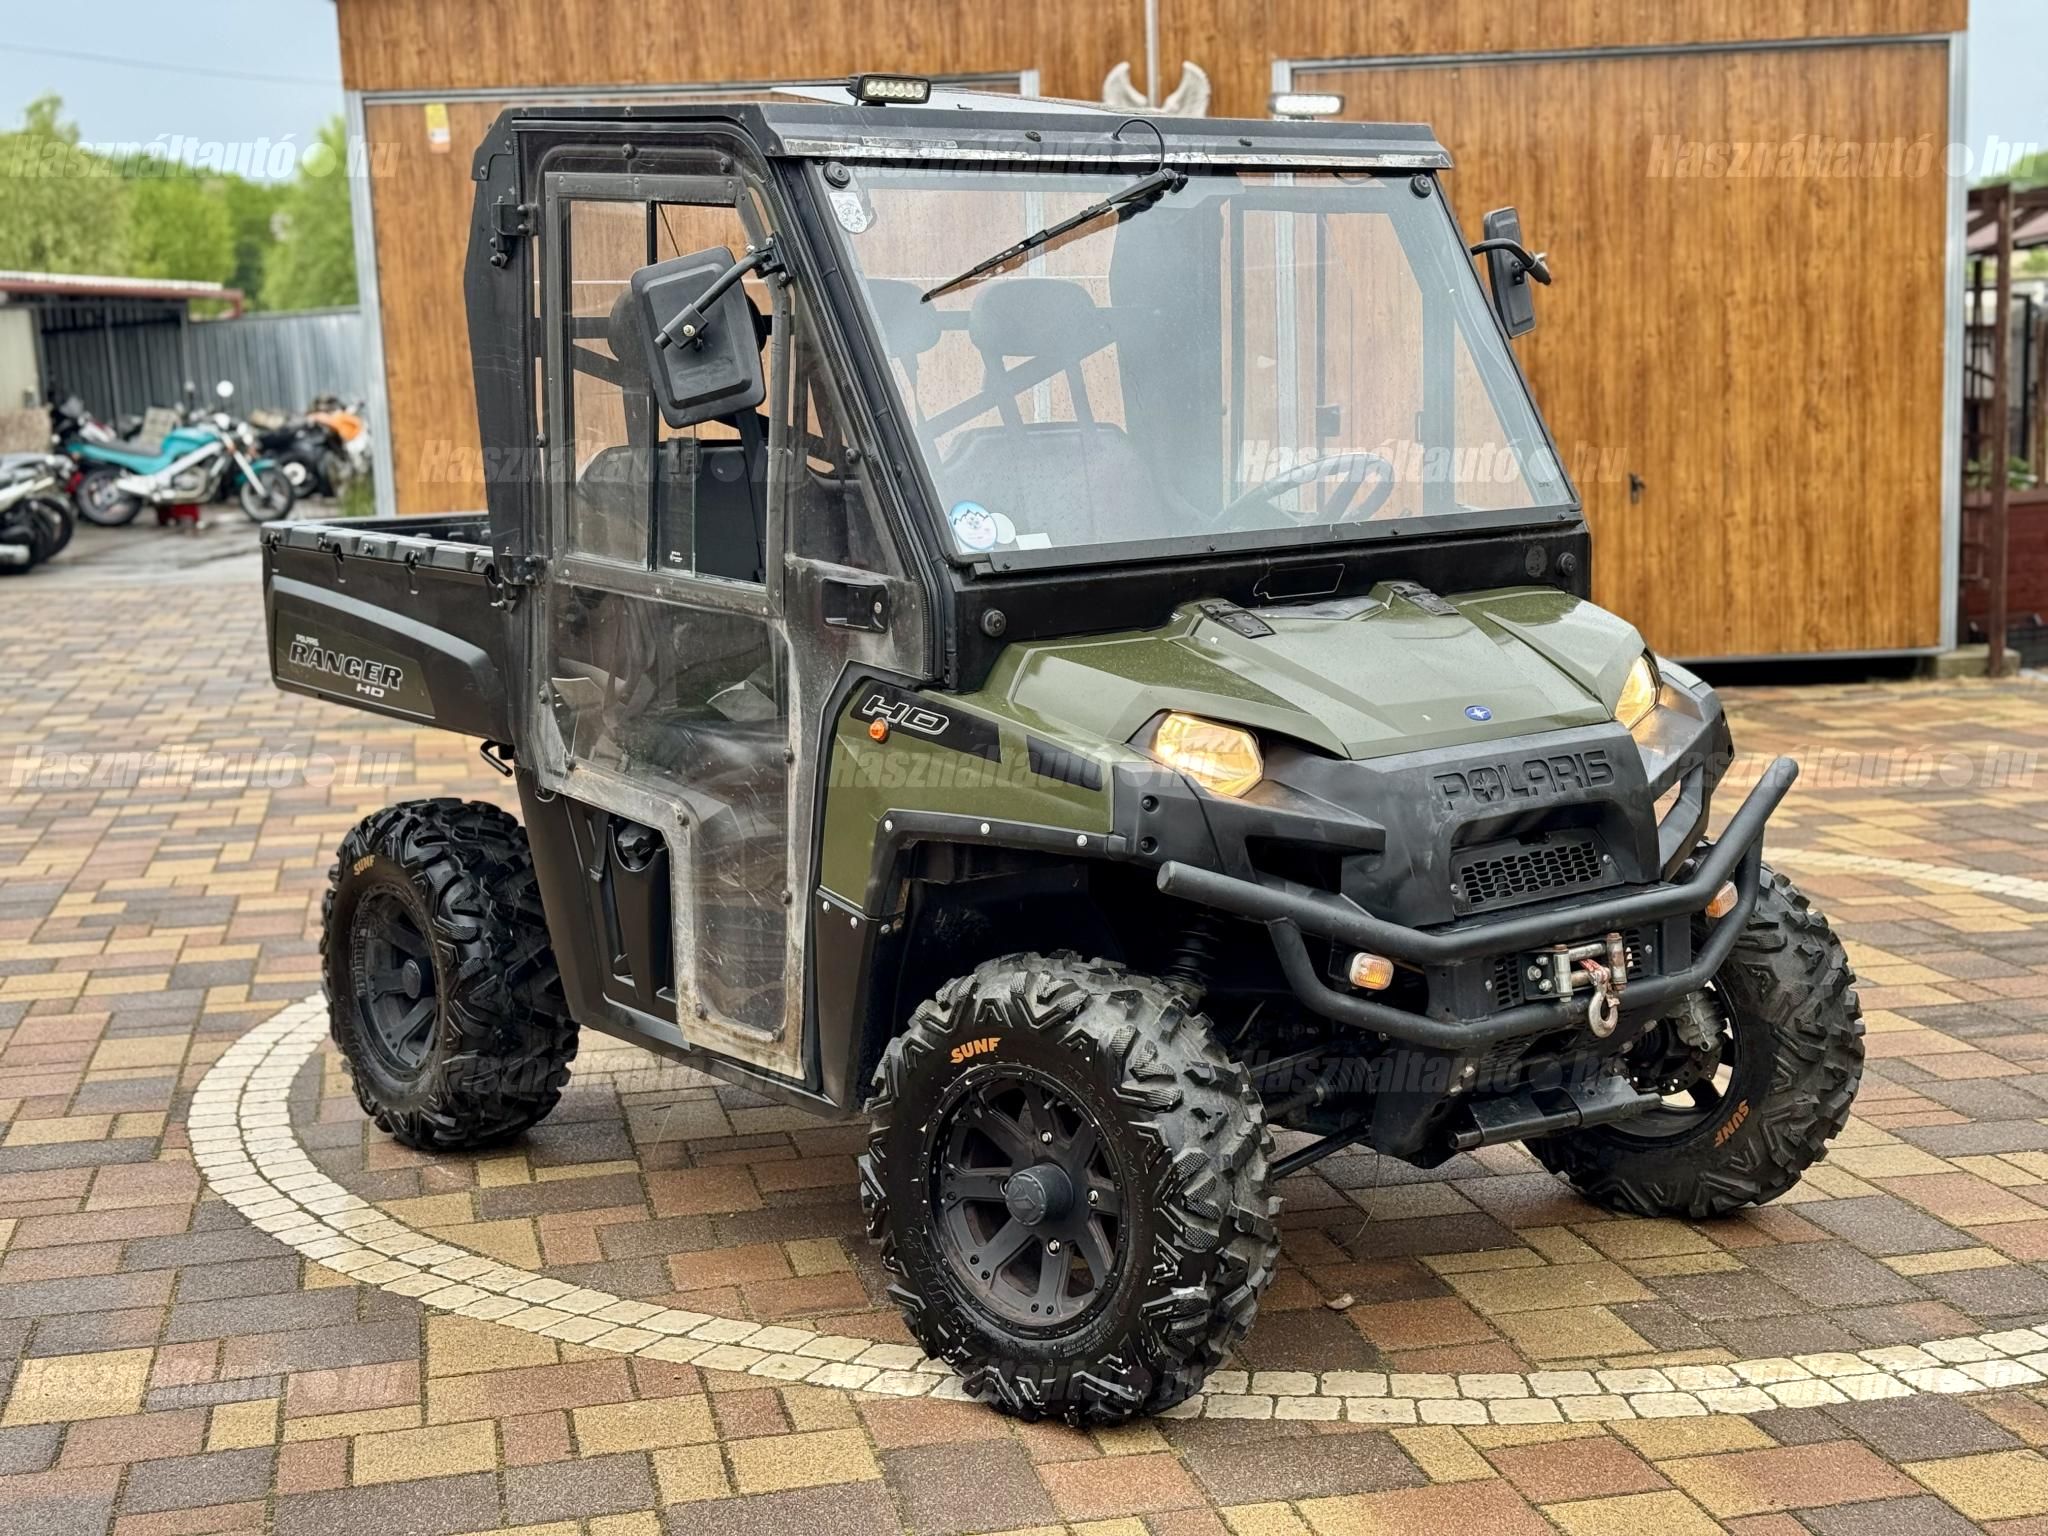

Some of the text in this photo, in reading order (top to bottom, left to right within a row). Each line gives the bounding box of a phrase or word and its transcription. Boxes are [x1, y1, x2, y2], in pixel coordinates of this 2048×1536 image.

[288, 641, 404, 691] RANGER
[356, 683, 385, 698] HD
[862, 694, 950, 735] HD
[1433, 750, 1615, 811] POLARIS
[950, 1037, 1001, 1064] SUNF
